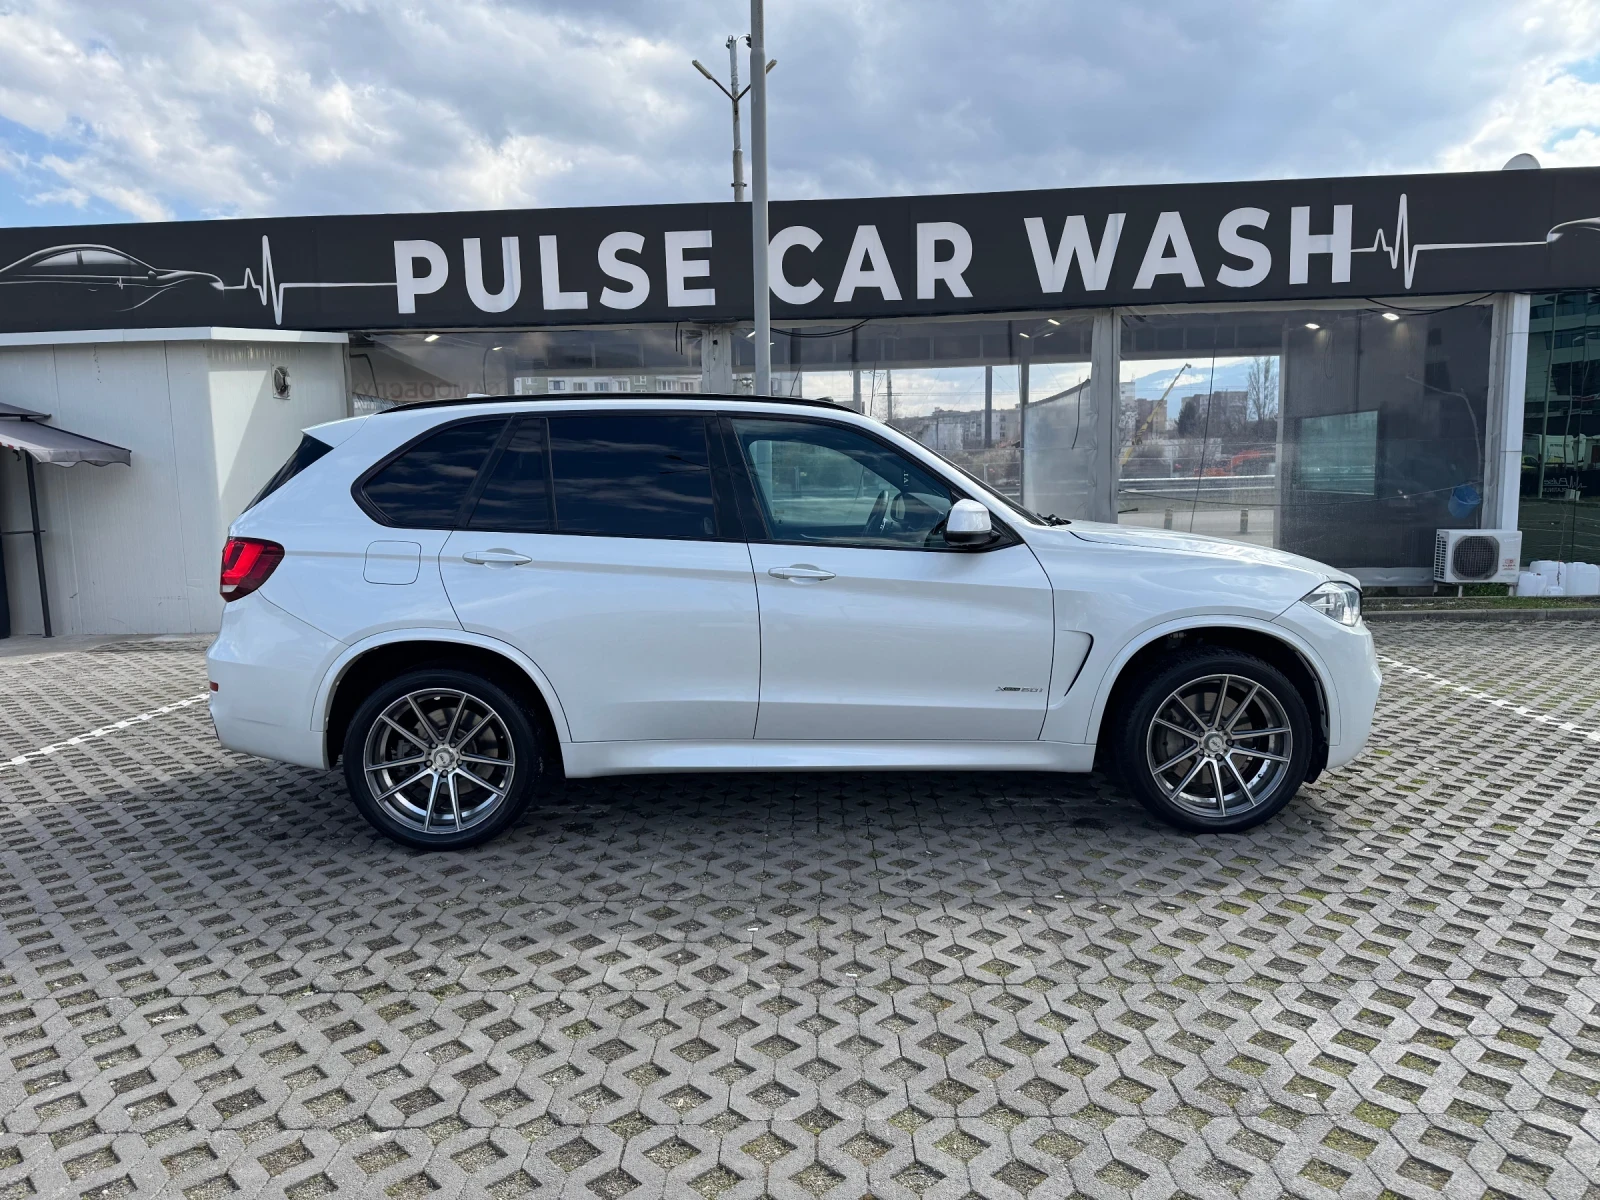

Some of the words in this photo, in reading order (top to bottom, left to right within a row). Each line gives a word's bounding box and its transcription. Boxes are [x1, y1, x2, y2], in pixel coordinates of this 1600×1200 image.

[393, 229, 716, 314] PULSE
[768, 221, 974, 305] CAR
[1023, 204, 1353, 294] WASH
